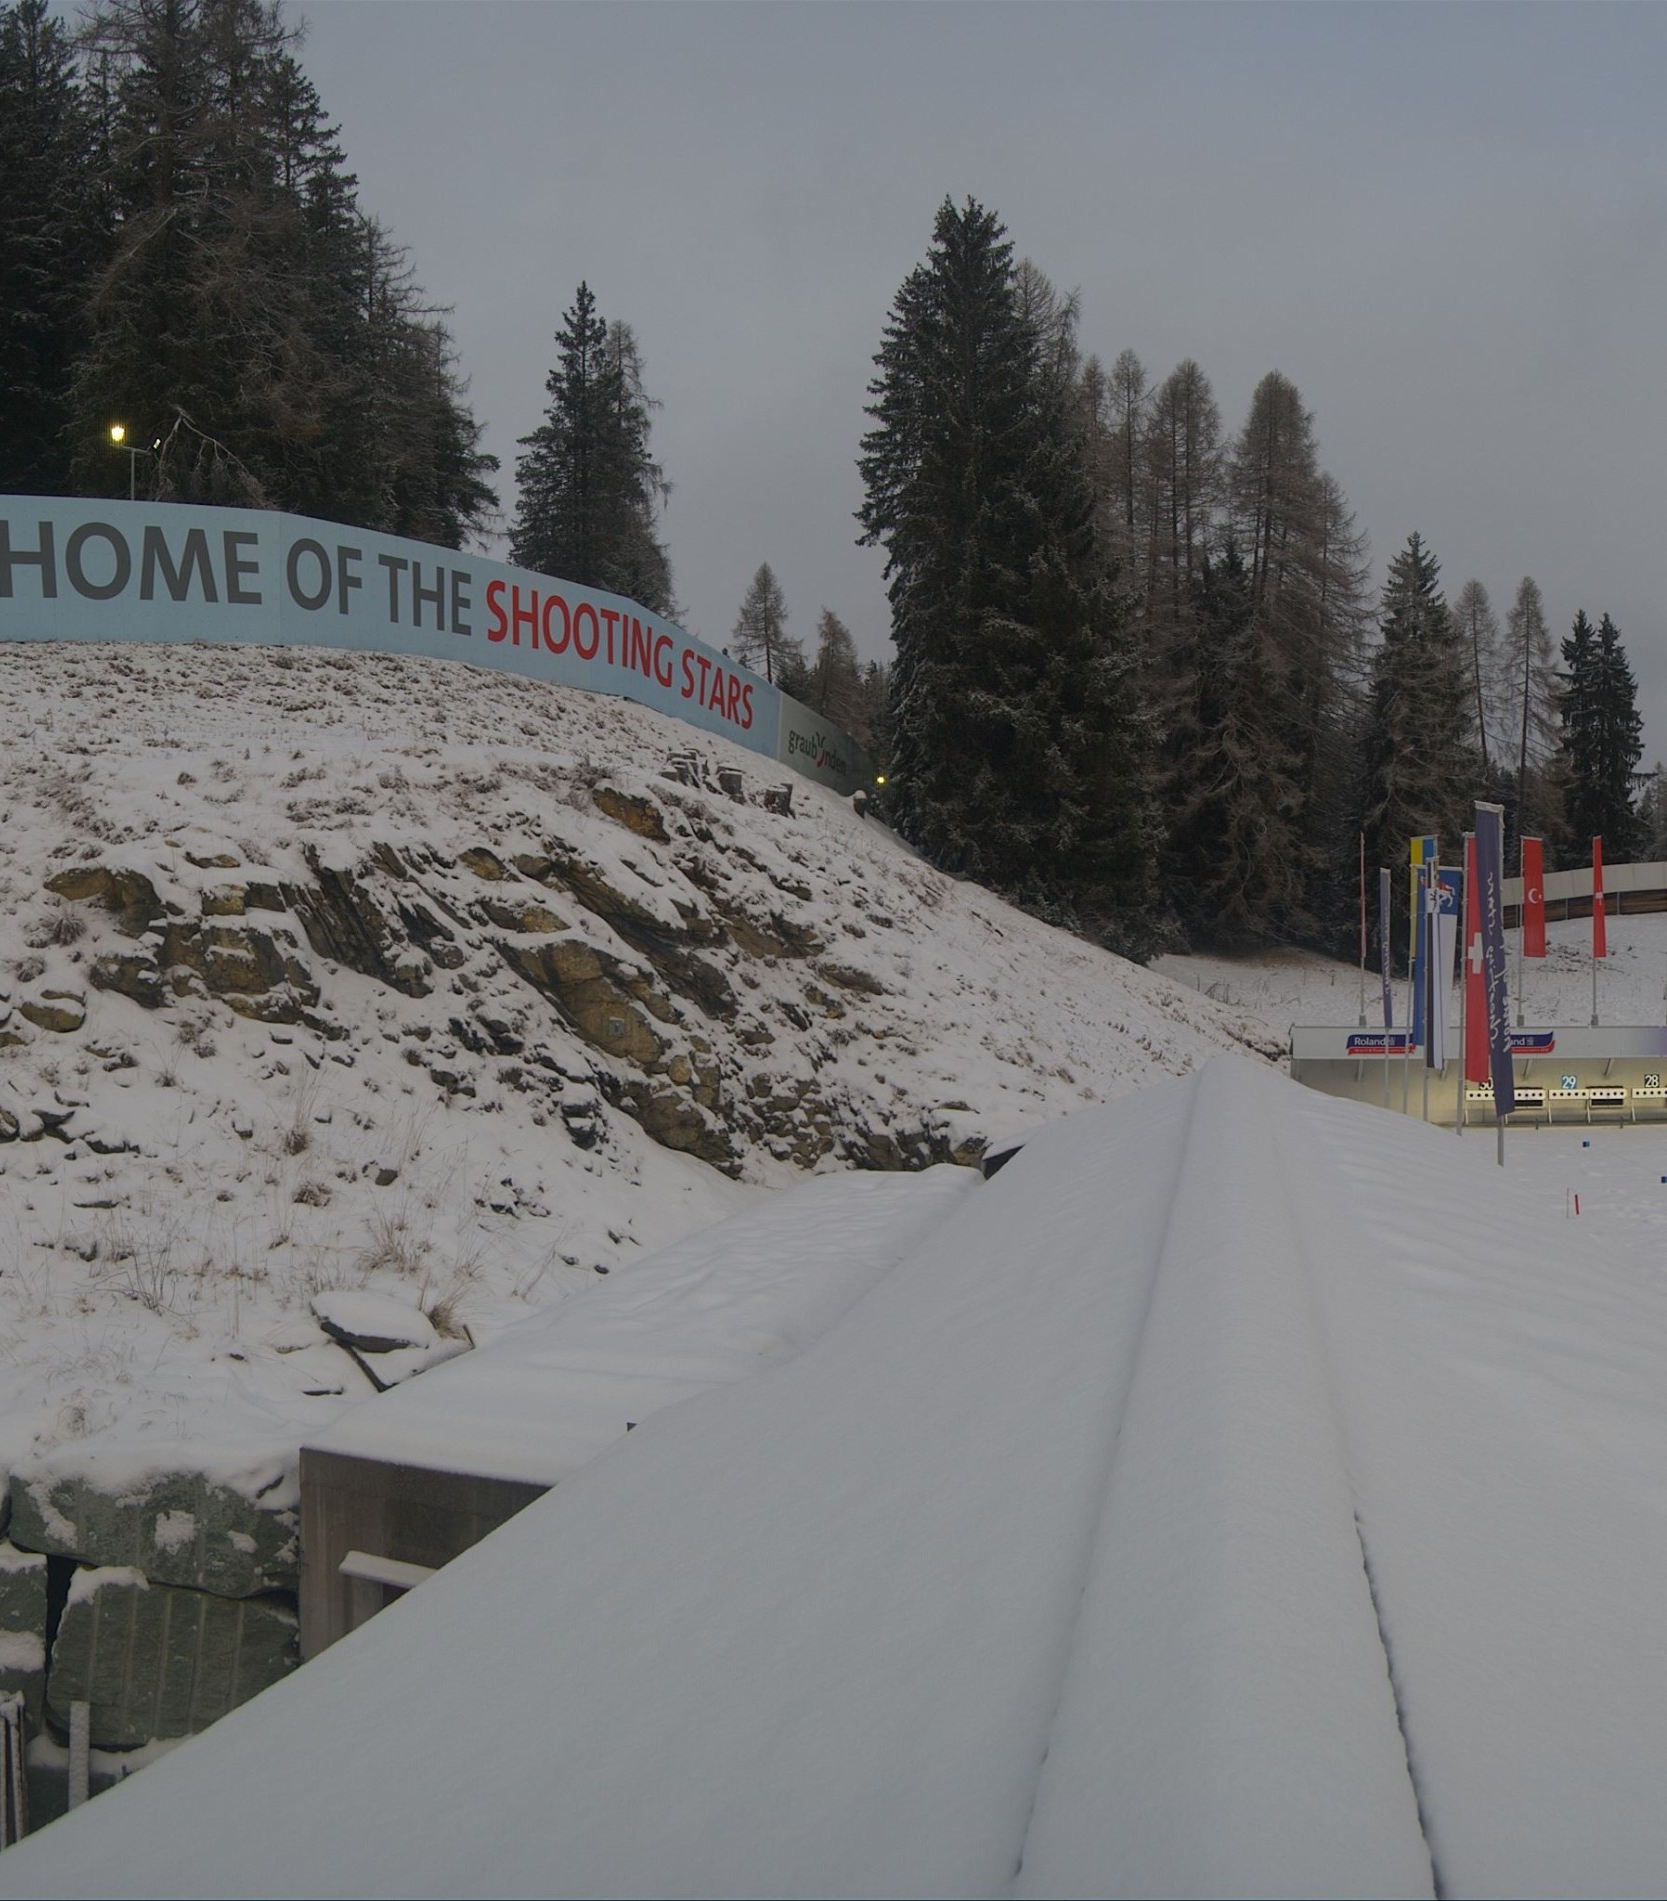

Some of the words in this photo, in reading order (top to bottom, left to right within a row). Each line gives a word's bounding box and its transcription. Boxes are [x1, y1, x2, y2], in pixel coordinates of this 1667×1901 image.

[285, 536, 363, 616] OF
[377, 552, 473, 637] THE
[485, 578, 675, 689] SHOOTING
[680, 647, 755, 732] STARS
[1354, 1037, 1386, 1046] Roland
[1562, 1076, 1576, 1089] 29
[1645, 1075, 1659, 1087] 28
